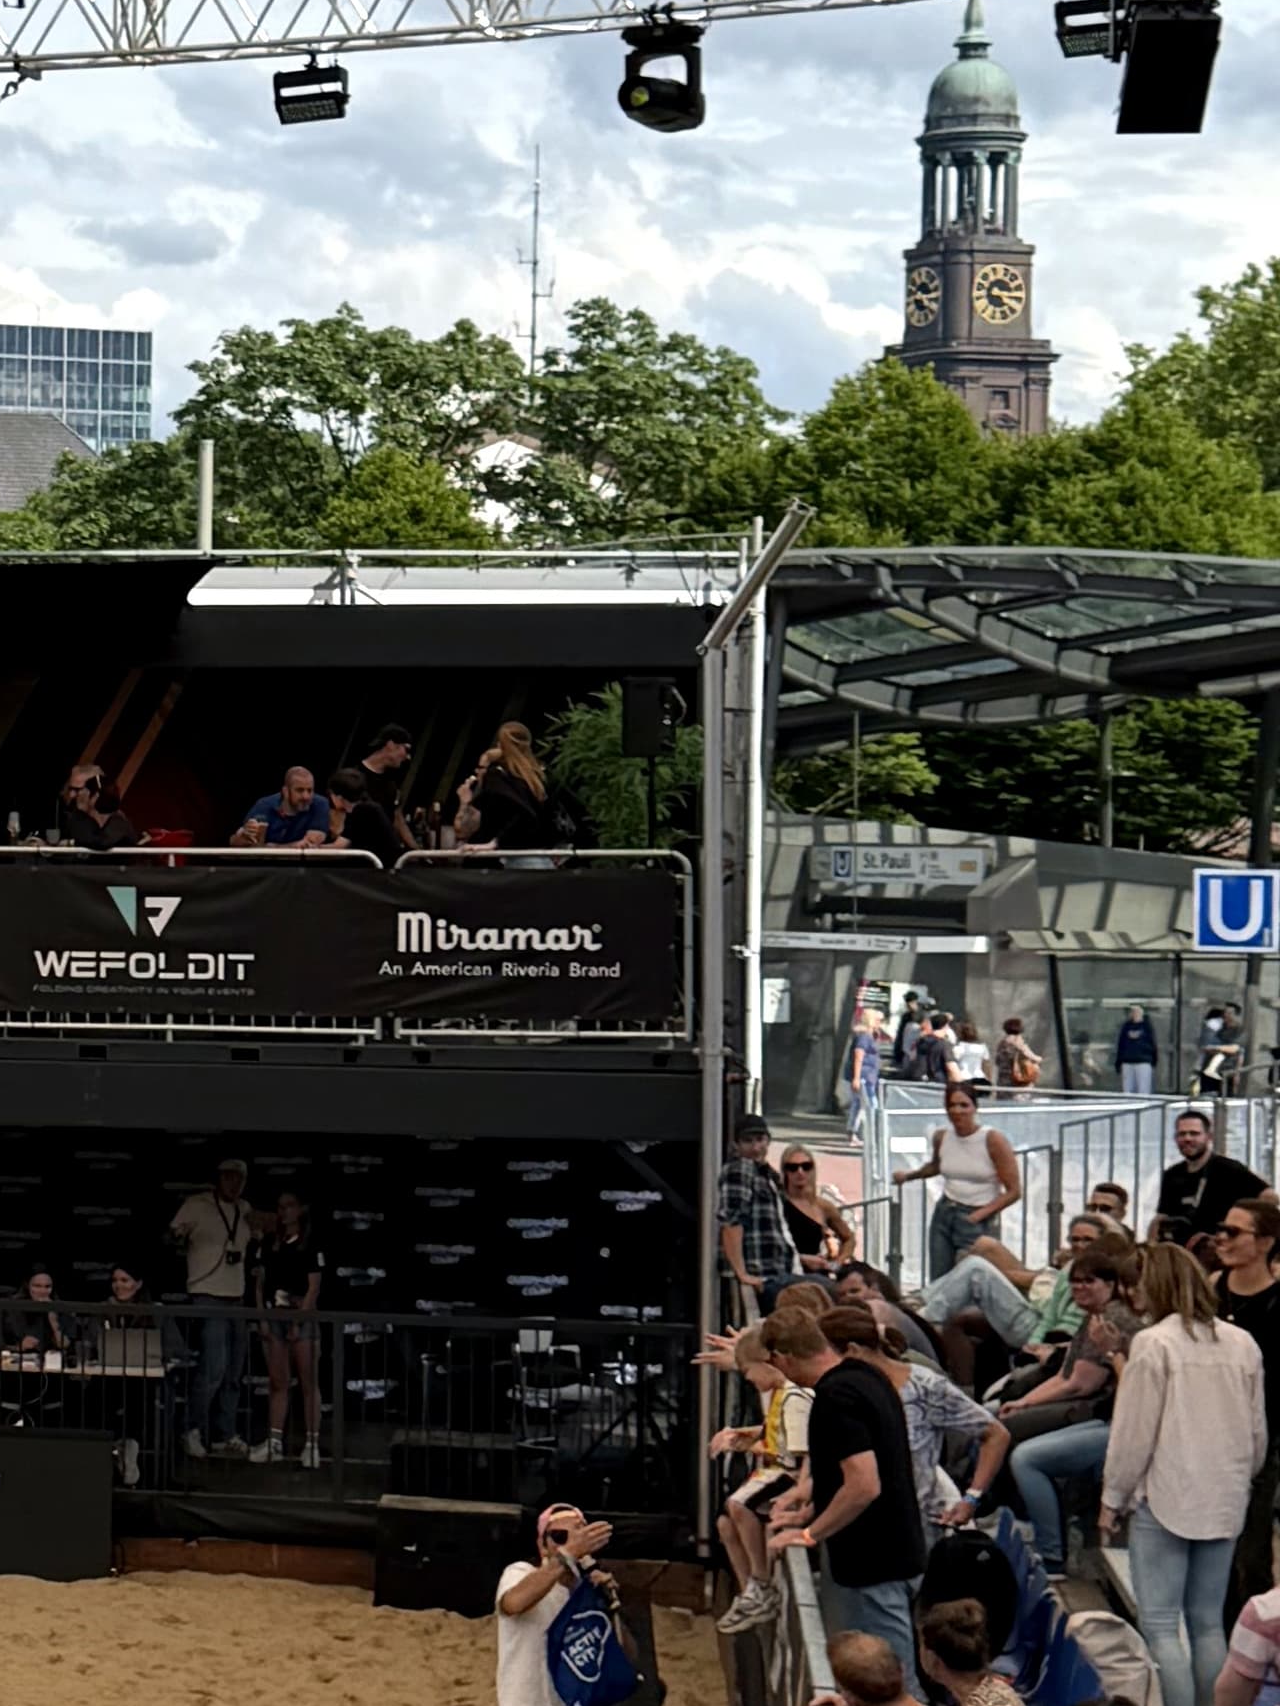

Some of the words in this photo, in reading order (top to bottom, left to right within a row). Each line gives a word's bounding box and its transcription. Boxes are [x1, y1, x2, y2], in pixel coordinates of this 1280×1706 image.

[1208, 878, 1265, 942] U
[33, 950, 255, 981] WEFOLDIT
[379, 962, 403, 976] An
[411, 962, 493, 977] American
[569, 962, 621, 978] Brand
